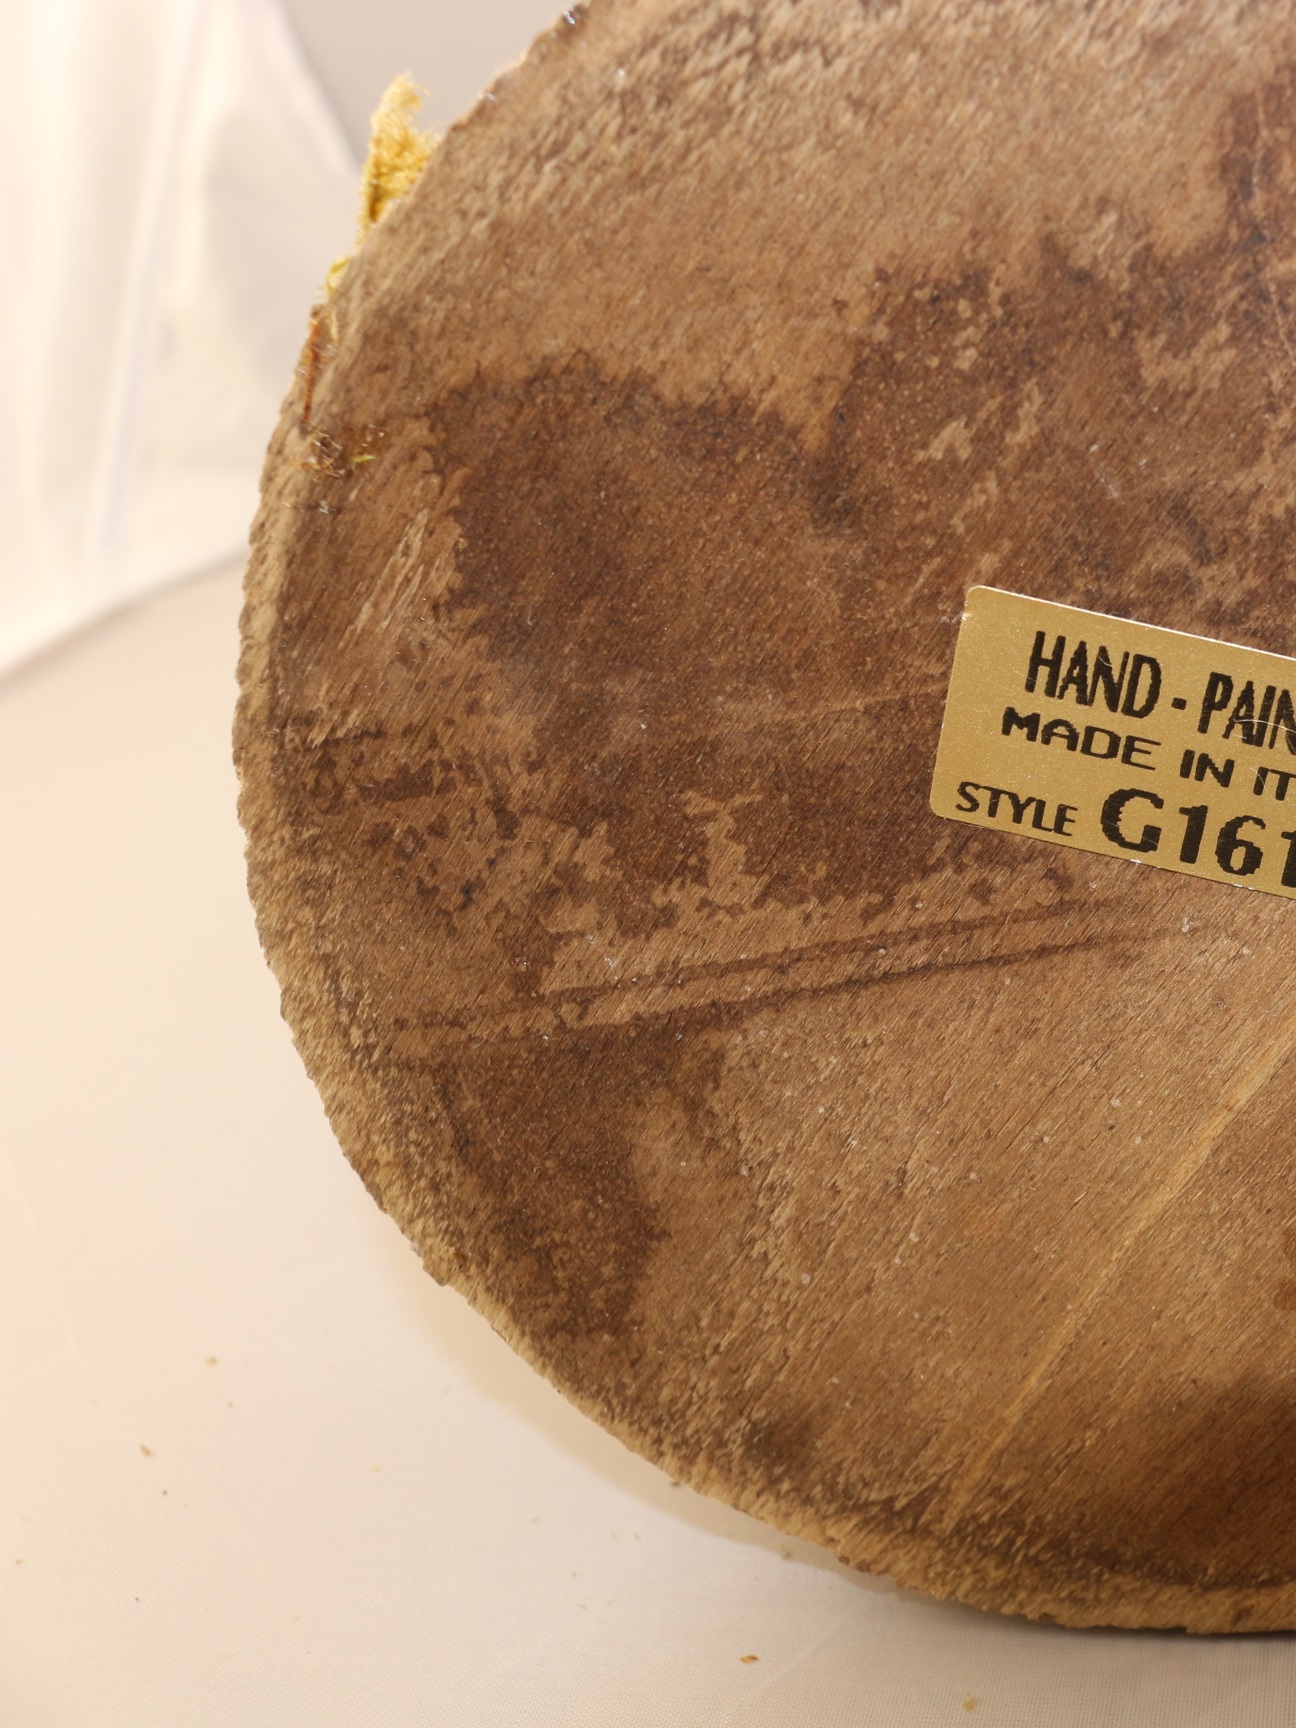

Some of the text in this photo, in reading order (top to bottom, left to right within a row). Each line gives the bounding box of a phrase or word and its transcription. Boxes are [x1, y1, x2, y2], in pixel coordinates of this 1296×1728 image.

[1024, 630, 1162, 719] HAND
[1001, 706, 1162, 771] MADE
[1179, 749, 1235, 788] IN
[955, 781, 1078, 837] STYLE
